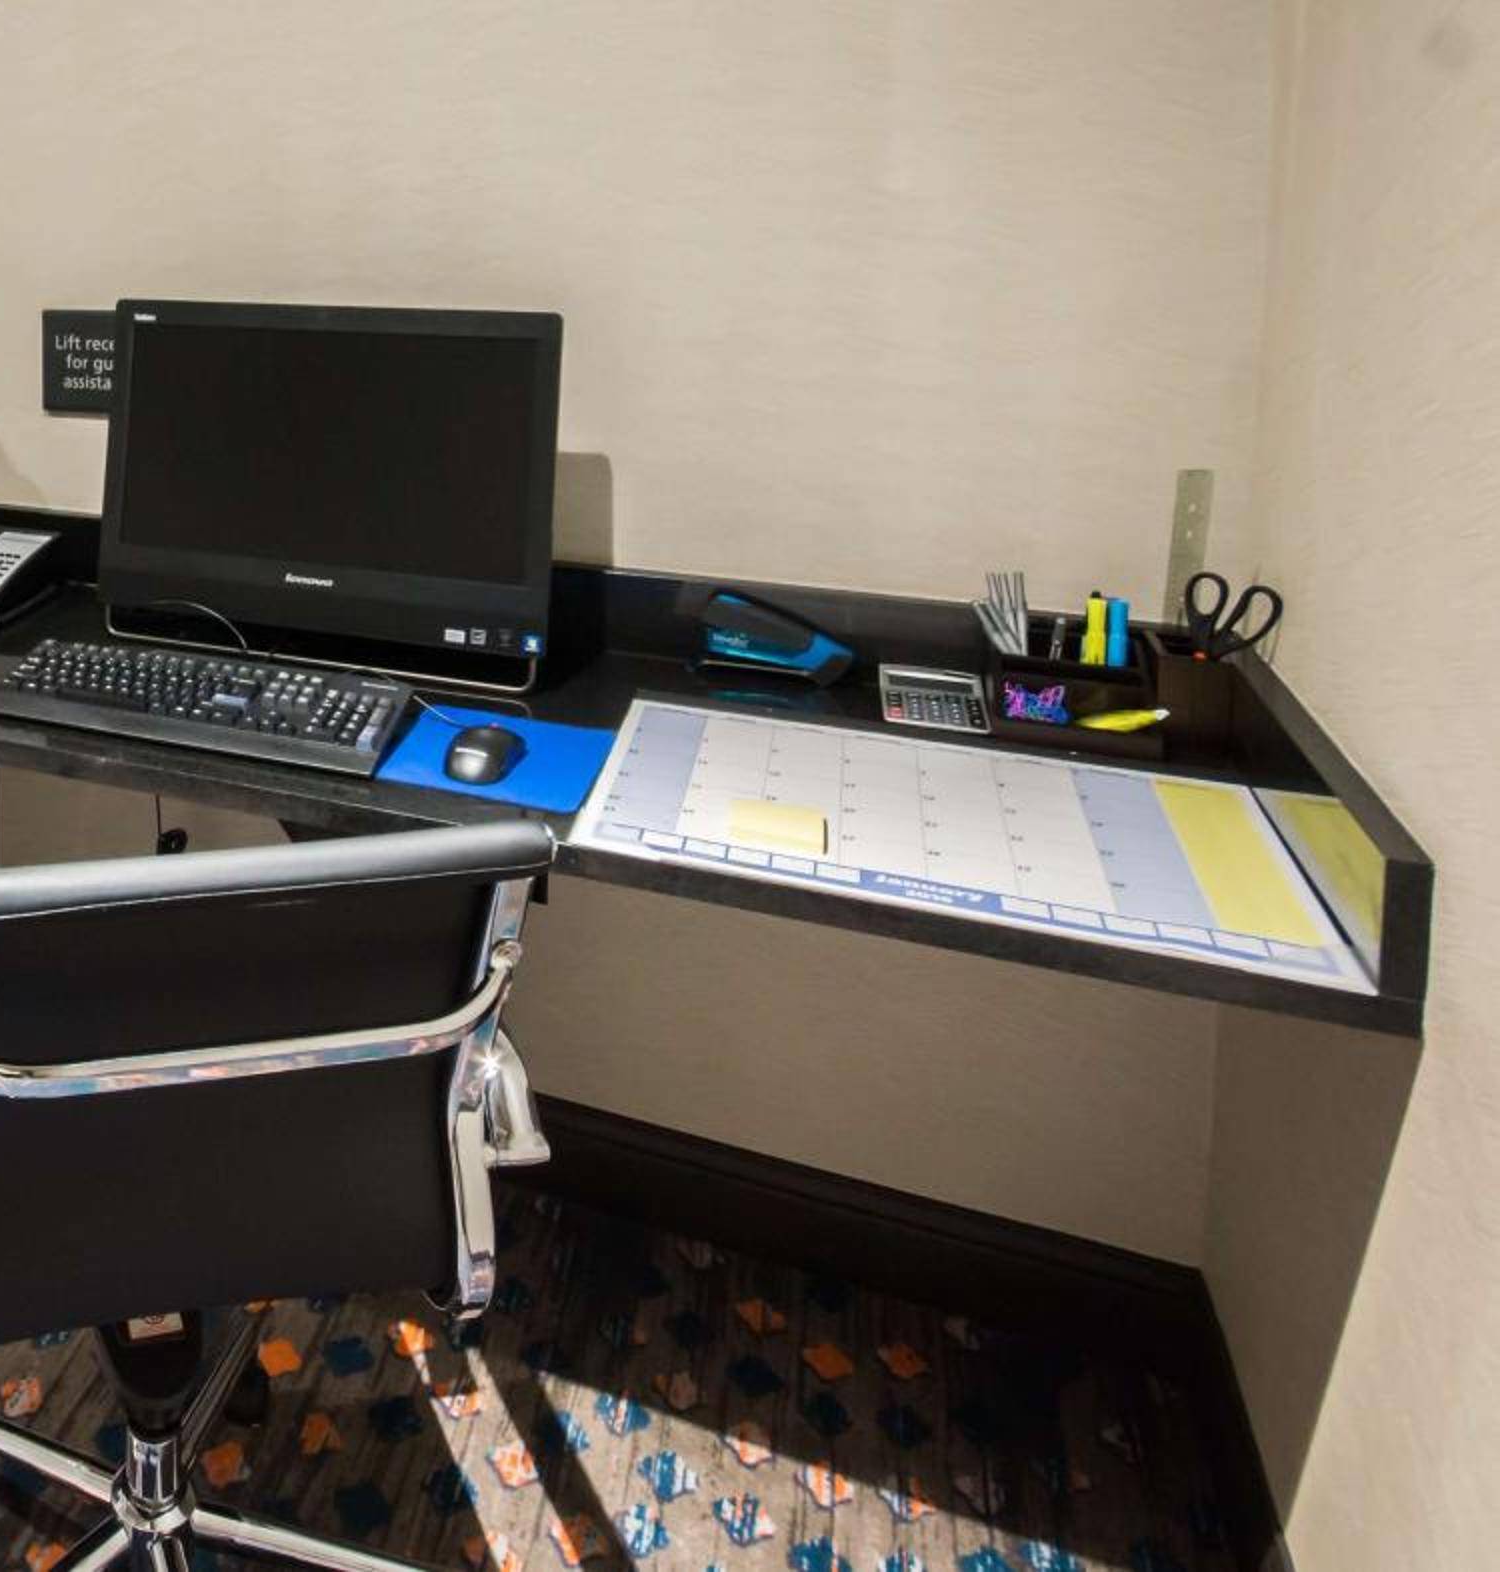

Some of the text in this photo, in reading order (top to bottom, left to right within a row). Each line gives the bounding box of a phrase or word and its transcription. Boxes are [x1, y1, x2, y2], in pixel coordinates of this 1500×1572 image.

[54, 334, 81, 351] Lift
[65, 354, 89, 369] for
[63, 376, 112, 391] assista
[875, 874, 982, 901] January
